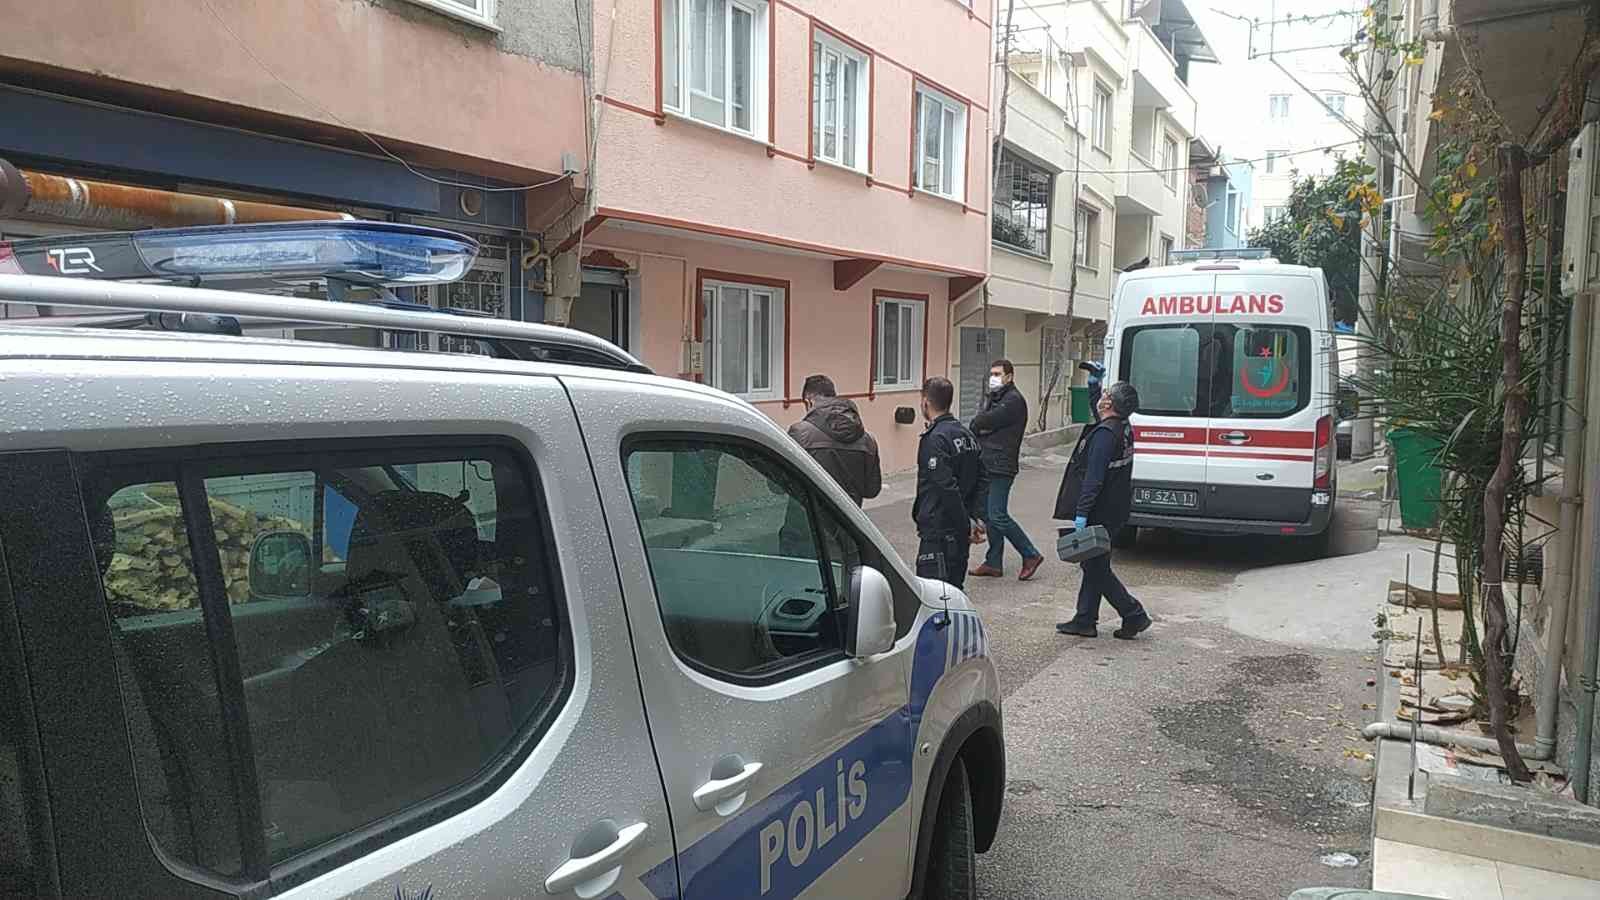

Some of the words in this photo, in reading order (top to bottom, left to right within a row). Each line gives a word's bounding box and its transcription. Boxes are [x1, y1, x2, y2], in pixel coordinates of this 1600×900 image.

[1141, 294, 1284, 315] AMBULANS
[1155, 490, 1177, 504] SZA
[759, 758, 868, 896] POLİS
